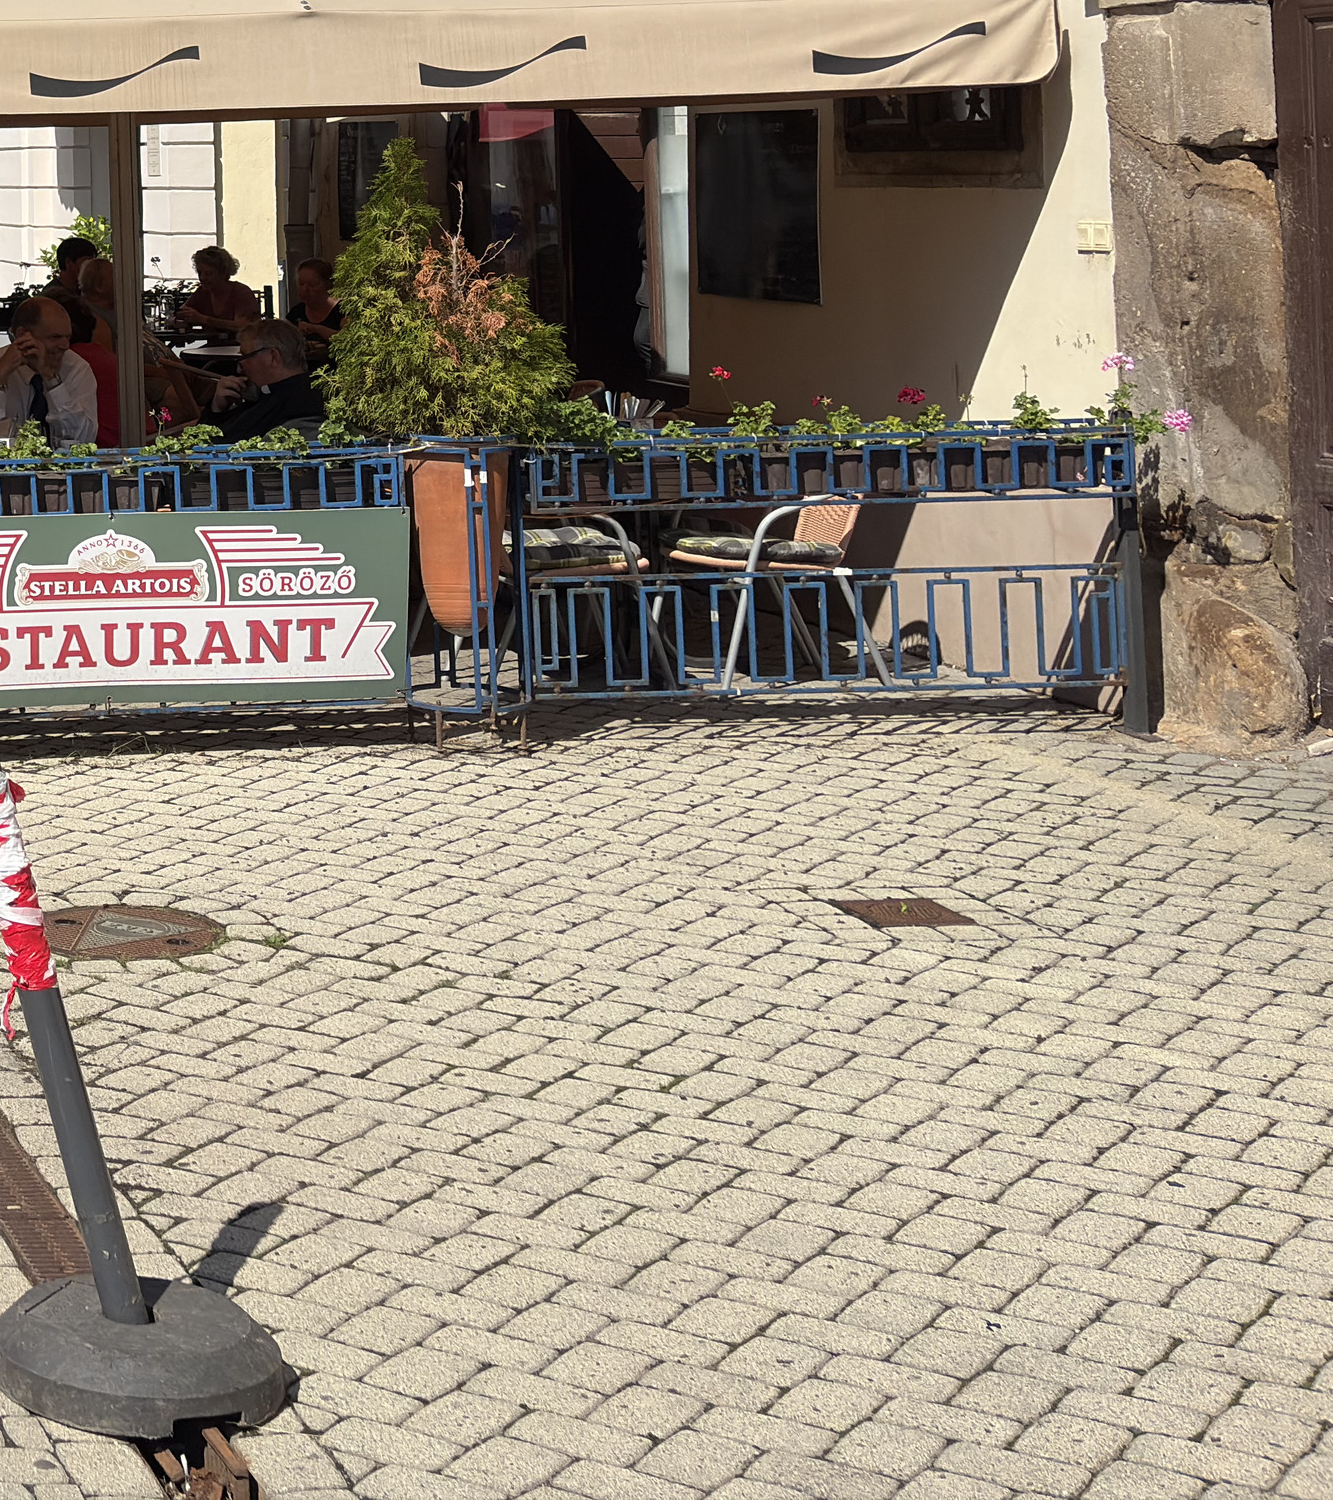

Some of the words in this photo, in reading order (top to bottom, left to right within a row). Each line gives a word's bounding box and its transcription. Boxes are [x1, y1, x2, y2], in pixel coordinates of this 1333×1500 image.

[76, 539, 104, 557] ANNO
[120, 539, 146, 555] 1366
[28, 580, 108, 598] STELLA
[111, 576, 193, 594] ARTOIS
[238, 565, 357, 597] SÖRÖZŐ
